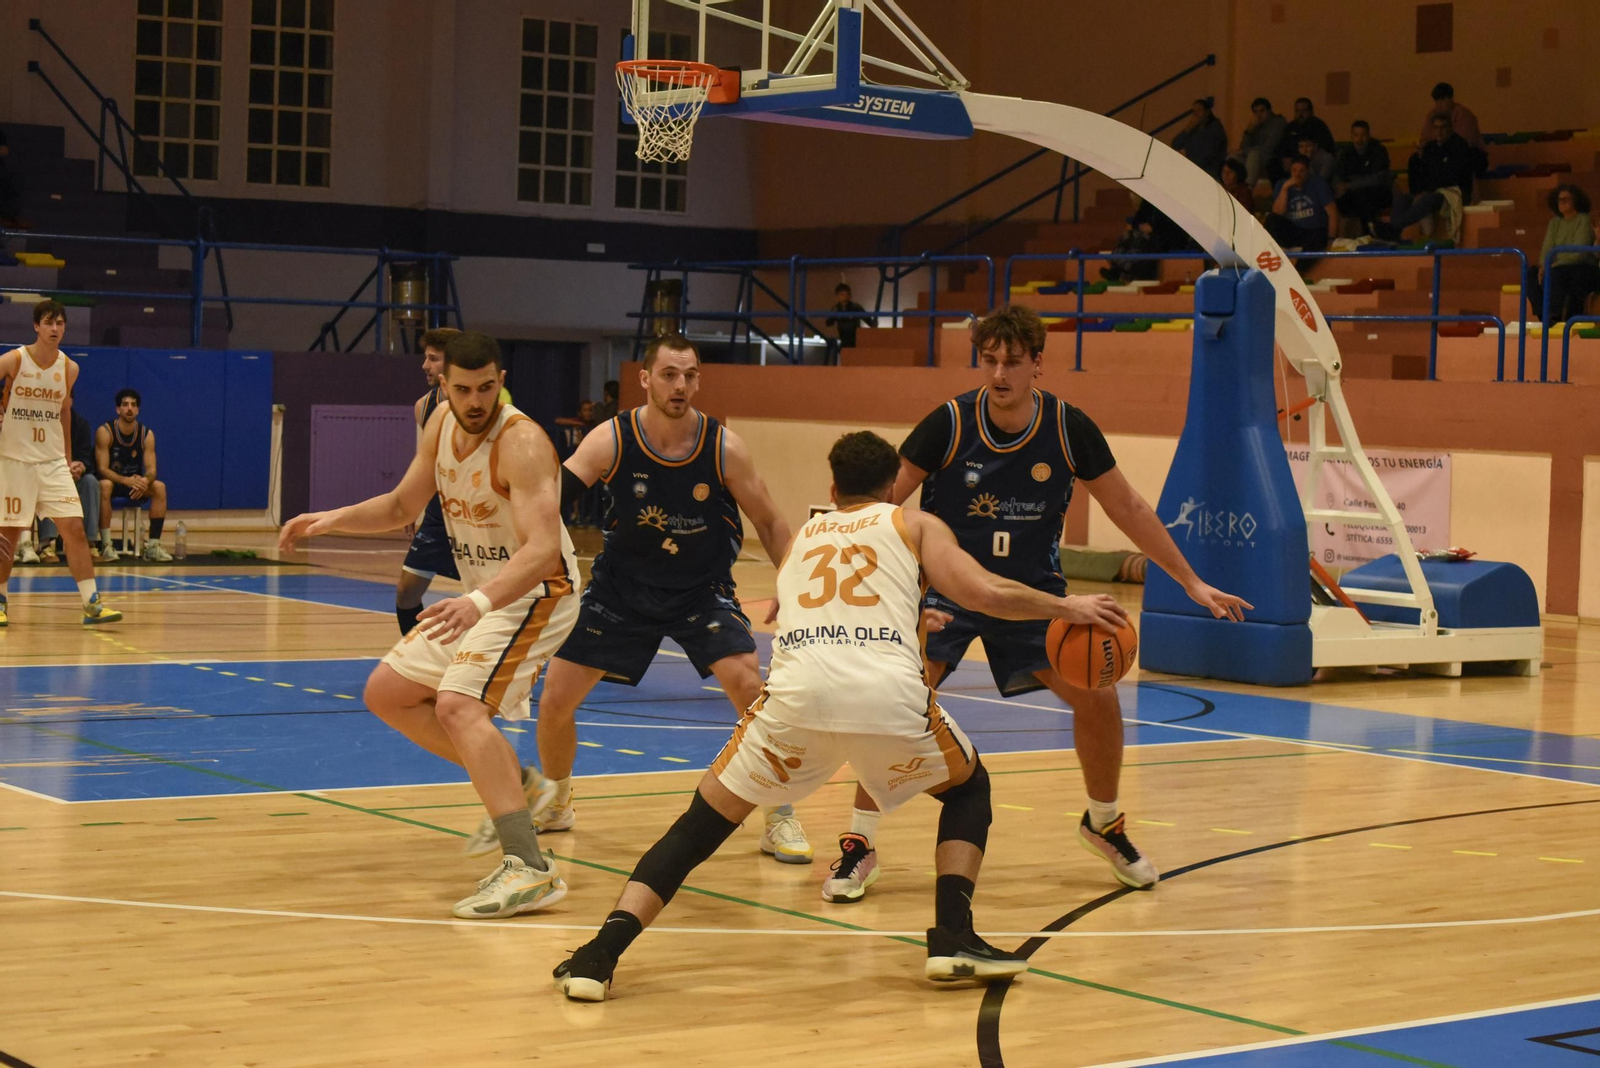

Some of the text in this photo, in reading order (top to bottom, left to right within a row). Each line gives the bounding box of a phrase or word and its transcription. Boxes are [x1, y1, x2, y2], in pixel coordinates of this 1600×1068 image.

[14, 386, 53, 399] CBCM
[12, 408, 43, 418] MOLINA
[32, 428, 46, 443] 10
[1383, 458, 1396, 468] TU
[1399, 456, 1444, 469] ENERGÍA
[4, 496, 22, 514] 10
[1198, 509, 1257, 540] IBERO
[661, 537, 679, 555] 4
[992, 531, 1010, 557] 0
[797, 543, 881, 609] 32
[778, 625, 903, 648] MOLINA OLEA
